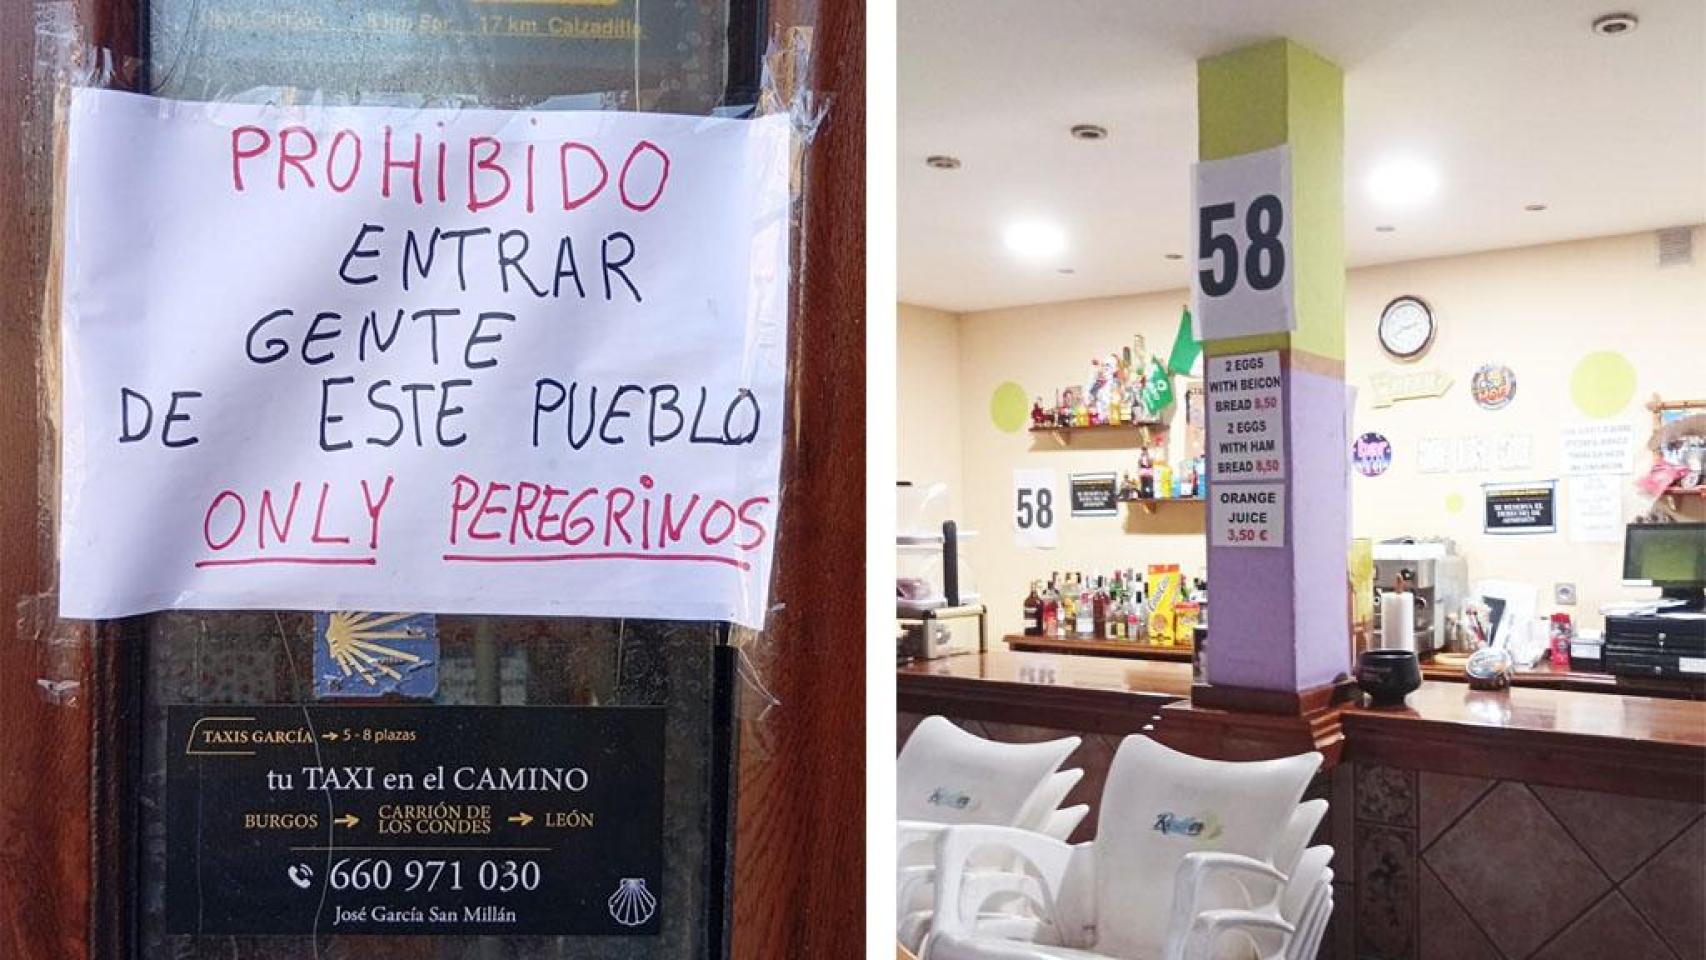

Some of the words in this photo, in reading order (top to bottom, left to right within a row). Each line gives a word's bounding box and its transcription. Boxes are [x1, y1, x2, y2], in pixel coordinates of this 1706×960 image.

[508, 15, 537, 33] km
[1198, 195, 1285, 297] 58
[339, 223, 642, 302] ENTRAR
[246, 309, 517, 369] GENTE
[1225, 360, 1232, 372] 2
[1235, 357, 1264, 370] EGGS
[1209, 380, 1238, 392] WITH
[1240, 376, 1280, 391] BEICON
[119, 387, 202, 448] DE
[319, 376, 473, 451] ESTE
[532, 378, 760, 451] PUEBLO
[1215, 399, 1252, 412] BREAD
[1227, 422, 1234, 434] 2
[1237, 420, 1267, 434] EGGS
[1220, 441, 1247, 454] WITH
[1250, 439, 1275, 452] HAM
[1218, 461, 1254, 474] BREAD
[1220, 492, 1276, 504] ORANGE
[204, 477, 394, 550] ONLY
[1017, 487, 1053, 529] 58
[1228, 512, 1268, 524] JUICE
[1227, 528, 1255, 541] 3,50
[203, 730, 249, 744] TAXIS
[252, 727, 313, 744] GARCÍA
[344, 729, 351, 741] 5
[363, 729, 371, 741] 8
[374, 728, 416, 744] plazas
[266, 769, 294, 790] tu
[302, 766, 374, 791] TAXI
[383, 772, 415, 791] en
[423, 766, 445, 791] el
[453, 766, 589, 792] CAMINO
[379, 801, 461, 820] CARRIÓN
[467, 805, 491, 819] DE
[546, 809, 594, 828] LEÓN
[245, 814, 318, 829] BURGOS
[379, 819, 412, 834] LOS
[417, 819, 491, 834] CONDES
[330, 858, 392, 891] 660
[404, 859, 463, 892] 971
[478, 860, 541, 891] 030
[333, 905, 367, 924] José
[371, 906, 424, 923] García
[428, 906, 458, 923] San
[463, 906, 517, 923] Millán
